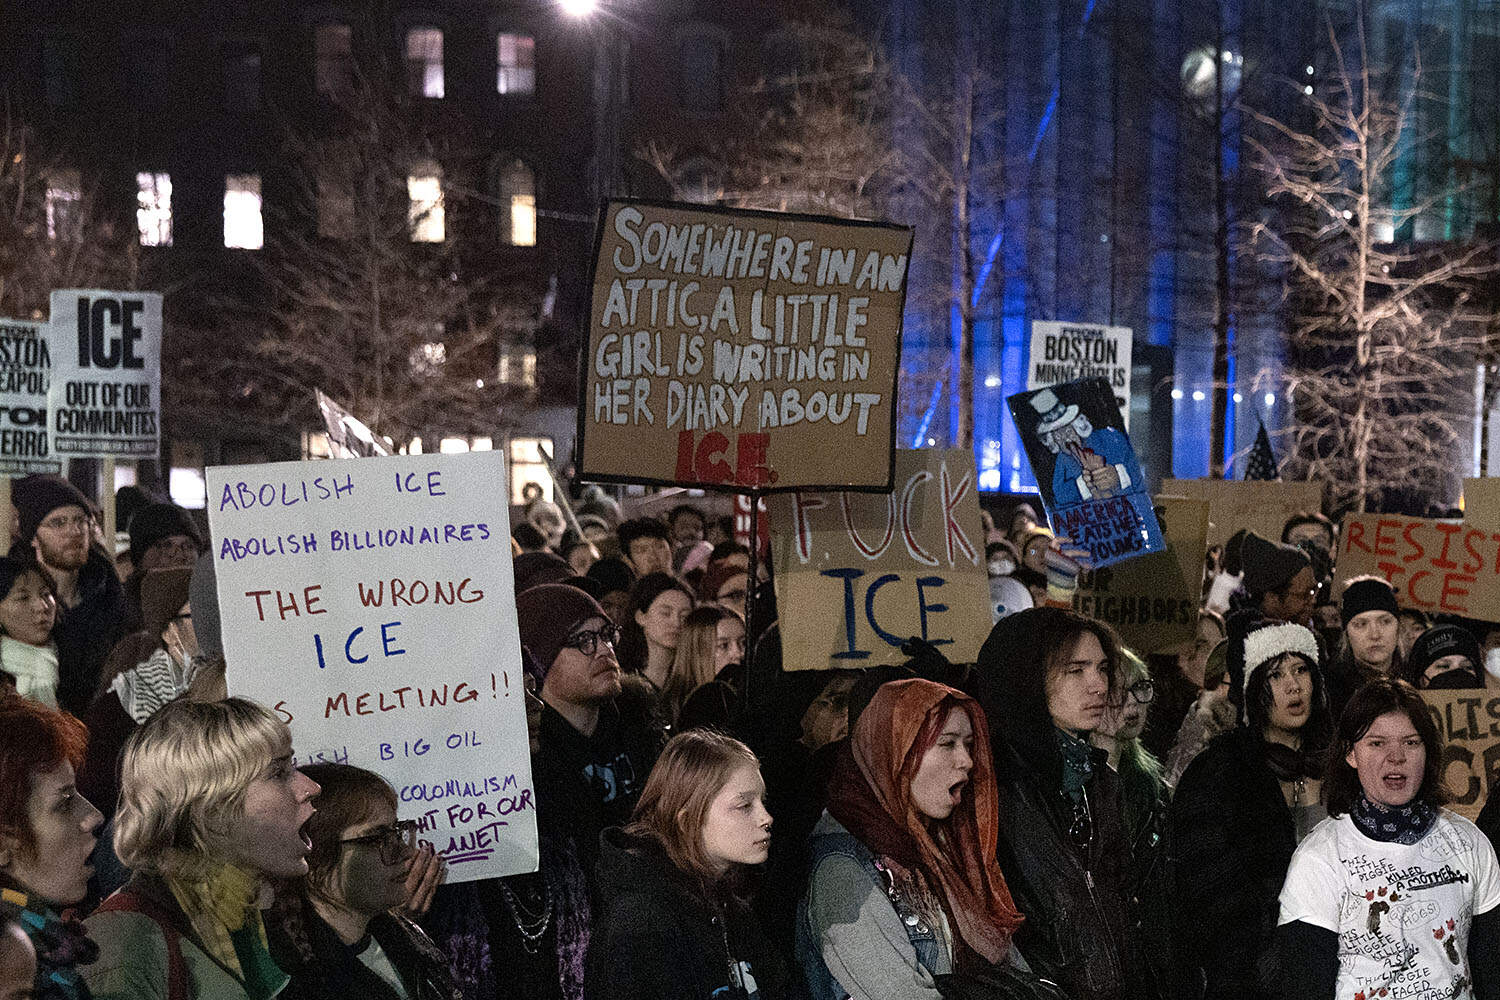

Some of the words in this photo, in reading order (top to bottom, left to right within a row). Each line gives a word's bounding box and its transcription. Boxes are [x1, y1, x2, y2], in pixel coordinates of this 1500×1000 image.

[612, 206, 814, 286] SOMEWHERE
[816, 247, 856, 288] IN
[856, 251, 908, 293] AN
[77, 296, 144, 369] ICE
[600, 278, 709, 333] ATTIC,
[709, 285, 740, 336] A
[750, 288, 871, 348] LITTLE
[0, 337, 50, 368] STON
[594, 330, 671, 379] GIRL
[676, 332, 705, 376] IS
[712, 337, 839, 385] WRITING
[842, 350, 870, 381] IN
[1045, 334, 1118, 365] BOSTON
[66, 382, 99, 406] OUT
[101, 383, 121, 407] OF
[593, 376, 654, 425] HER
[666, 380, 750, 431] DIARY
[760, 388, 882, 437] ABOUT
[1, 429, 48, 457] ERRO
[218, 473, 354, 512] ABOLISH
[396, 471, 446, 498] ICE
[791, 460, 979, 566] FUCK
[1053, 495, 1137, 534] AMERICA
[219, 536, 318, 562] ABOLISH
[330, 523, 492, 552] BILLIONAIRES
[245, 585, 327, 622] THE
[358, 577, 484, 607] WRONG
[1377, 561, 1477, 613] ICE
[820, 567, 955, 660] ICE
[313, 620, 406, 669] ICE
[273, 700, 294, 724] S
[379, 736, 431, 761] BIG
[445, 730, 482, 749] OIL
[400, 774, 517, 802] COLONIALISM
[446, 804, 496, 828] FOR
[497, 789, 535, 816] OUR
[1349, 857, 1387, 877] LITTLE
[1358, 863, 1397, 883] PIGGIE
[1385, 865, 1425, 885] KILLED
[1396, 881, 1405, 892] A
[1391, 980, 1432, 999] FACED
